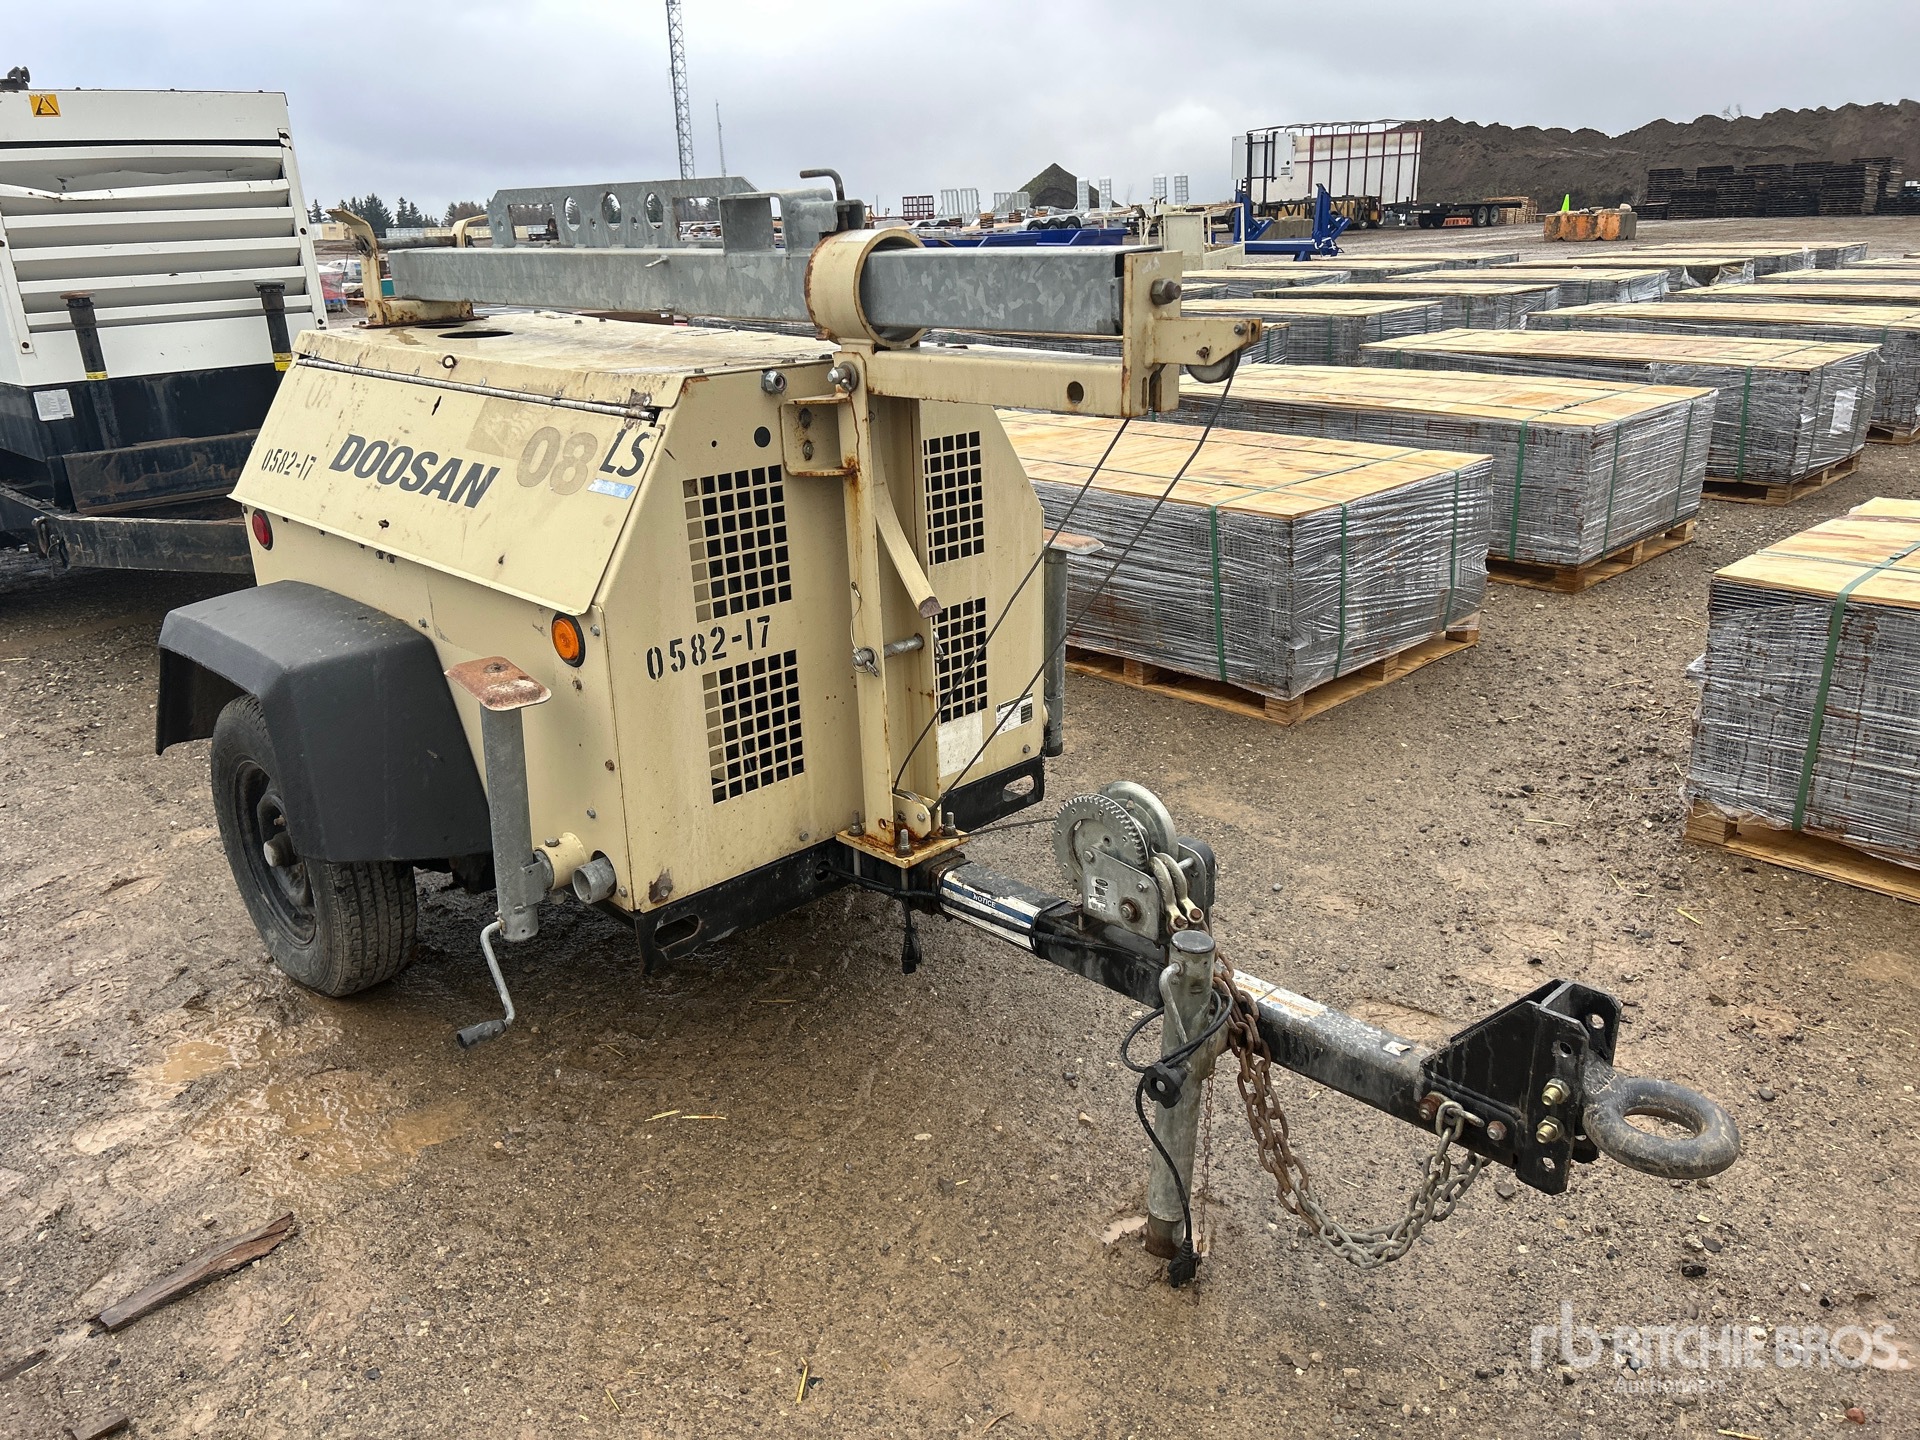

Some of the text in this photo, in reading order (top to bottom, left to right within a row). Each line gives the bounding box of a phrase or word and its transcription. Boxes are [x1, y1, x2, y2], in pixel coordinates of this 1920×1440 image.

[261, 448, 318, 481] 0582-17
[328, 433, 501, 509] DOOSAN
[517, 426, 650, 496] 08 LS
[646, 615, 770, 681] 0582-17
[972, 892, 996, 909] NOTICE
